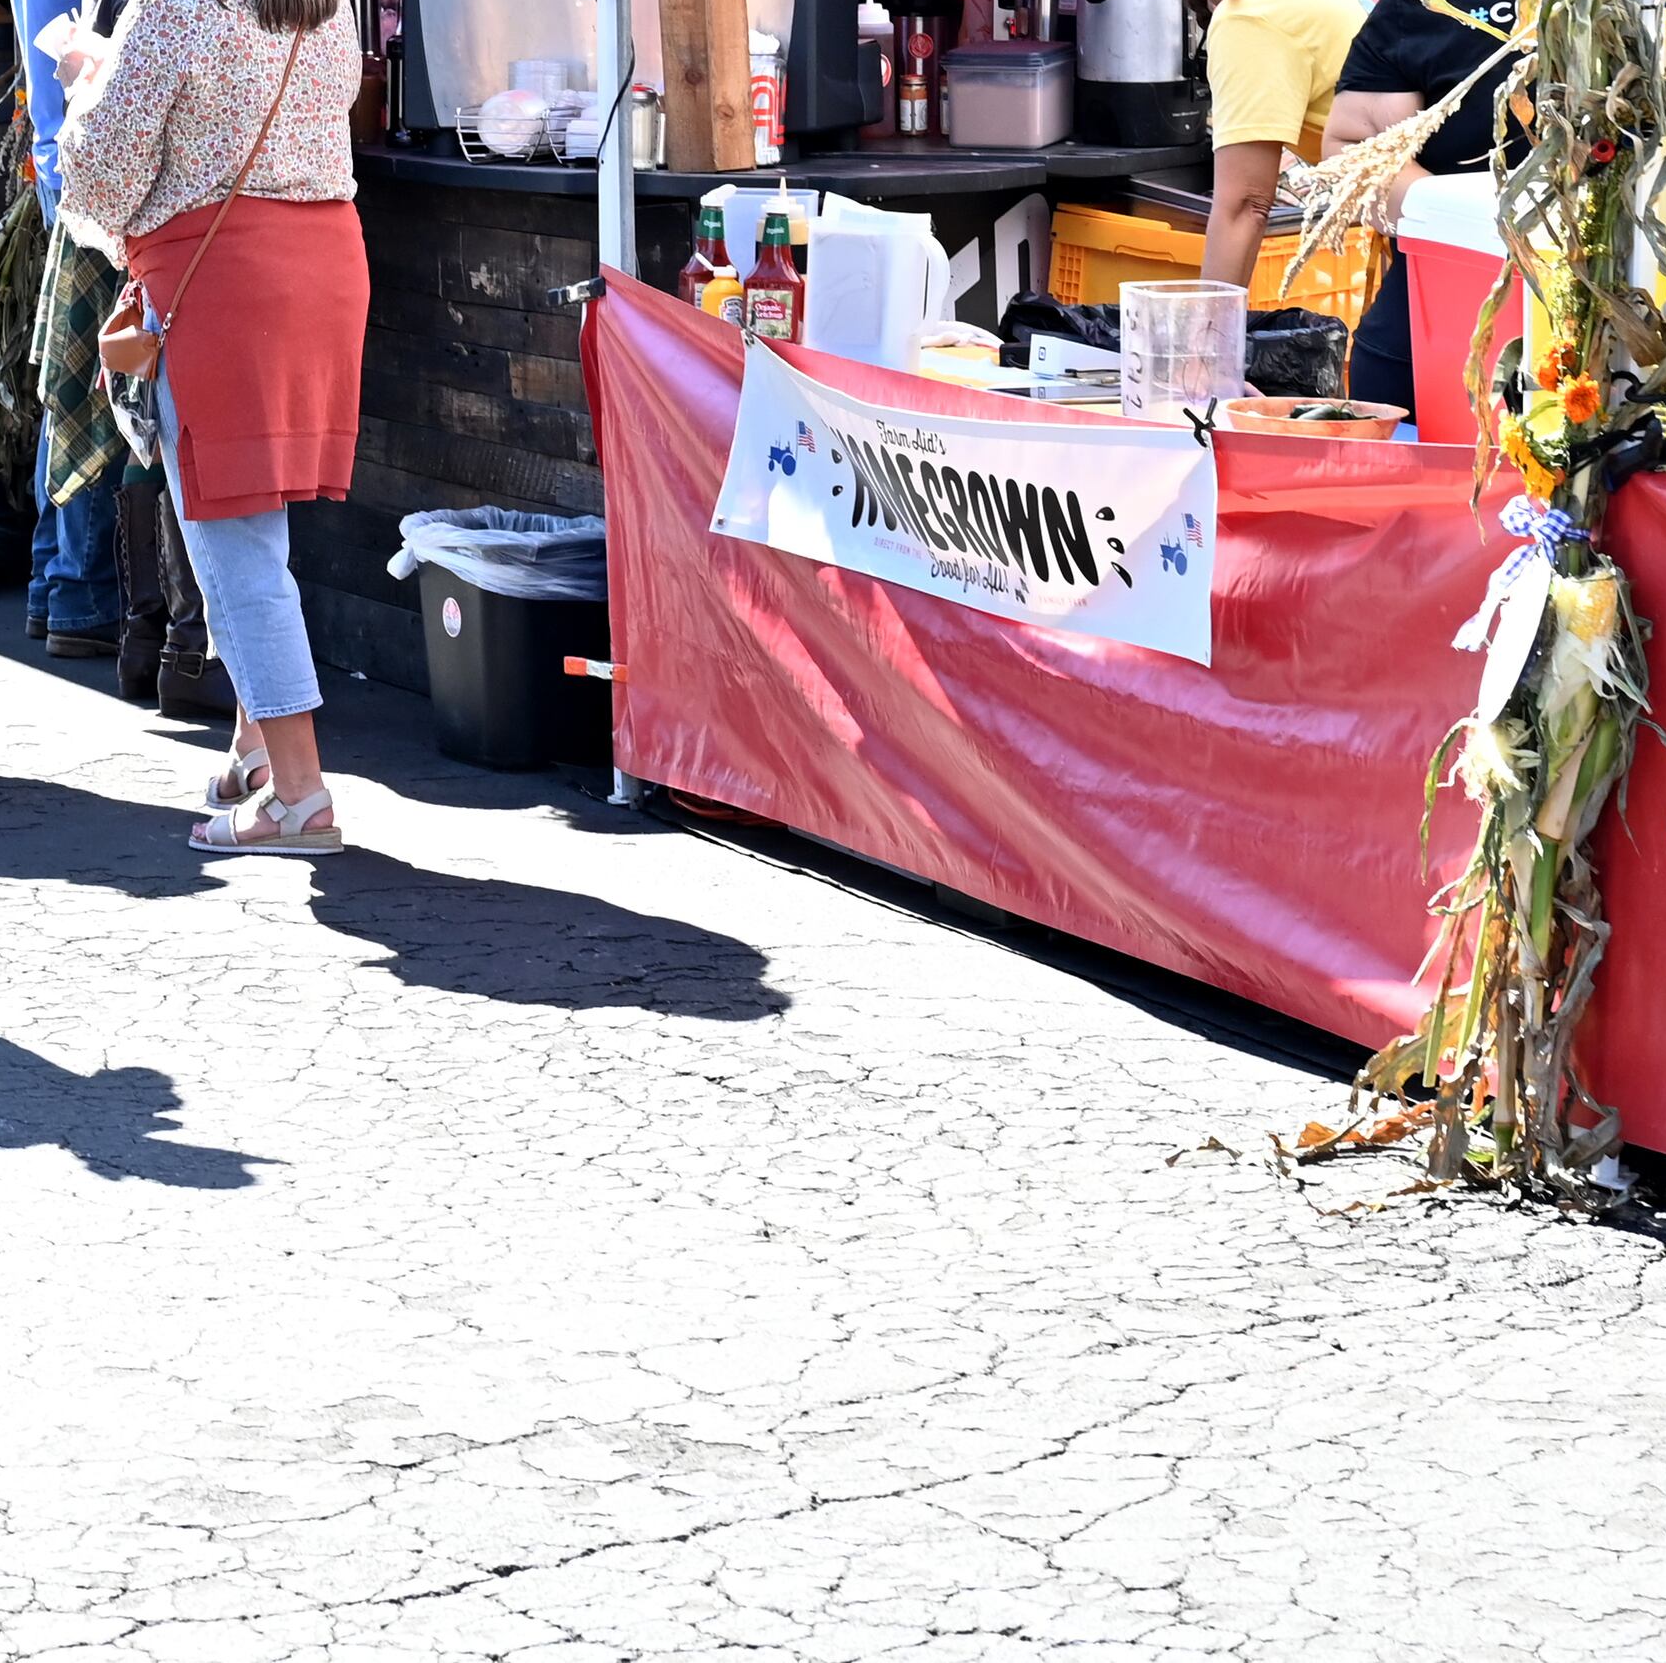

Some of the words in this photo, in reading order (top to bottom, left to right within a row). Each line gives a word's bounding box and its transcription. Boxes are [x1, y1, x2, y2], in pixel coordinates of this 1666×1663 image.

[754, 302, 782, 313] Organic
[876, 418, 912, 449] Farm
[912, 427, 947, 456] Aid's
[929, 548, 963, 579] Food
